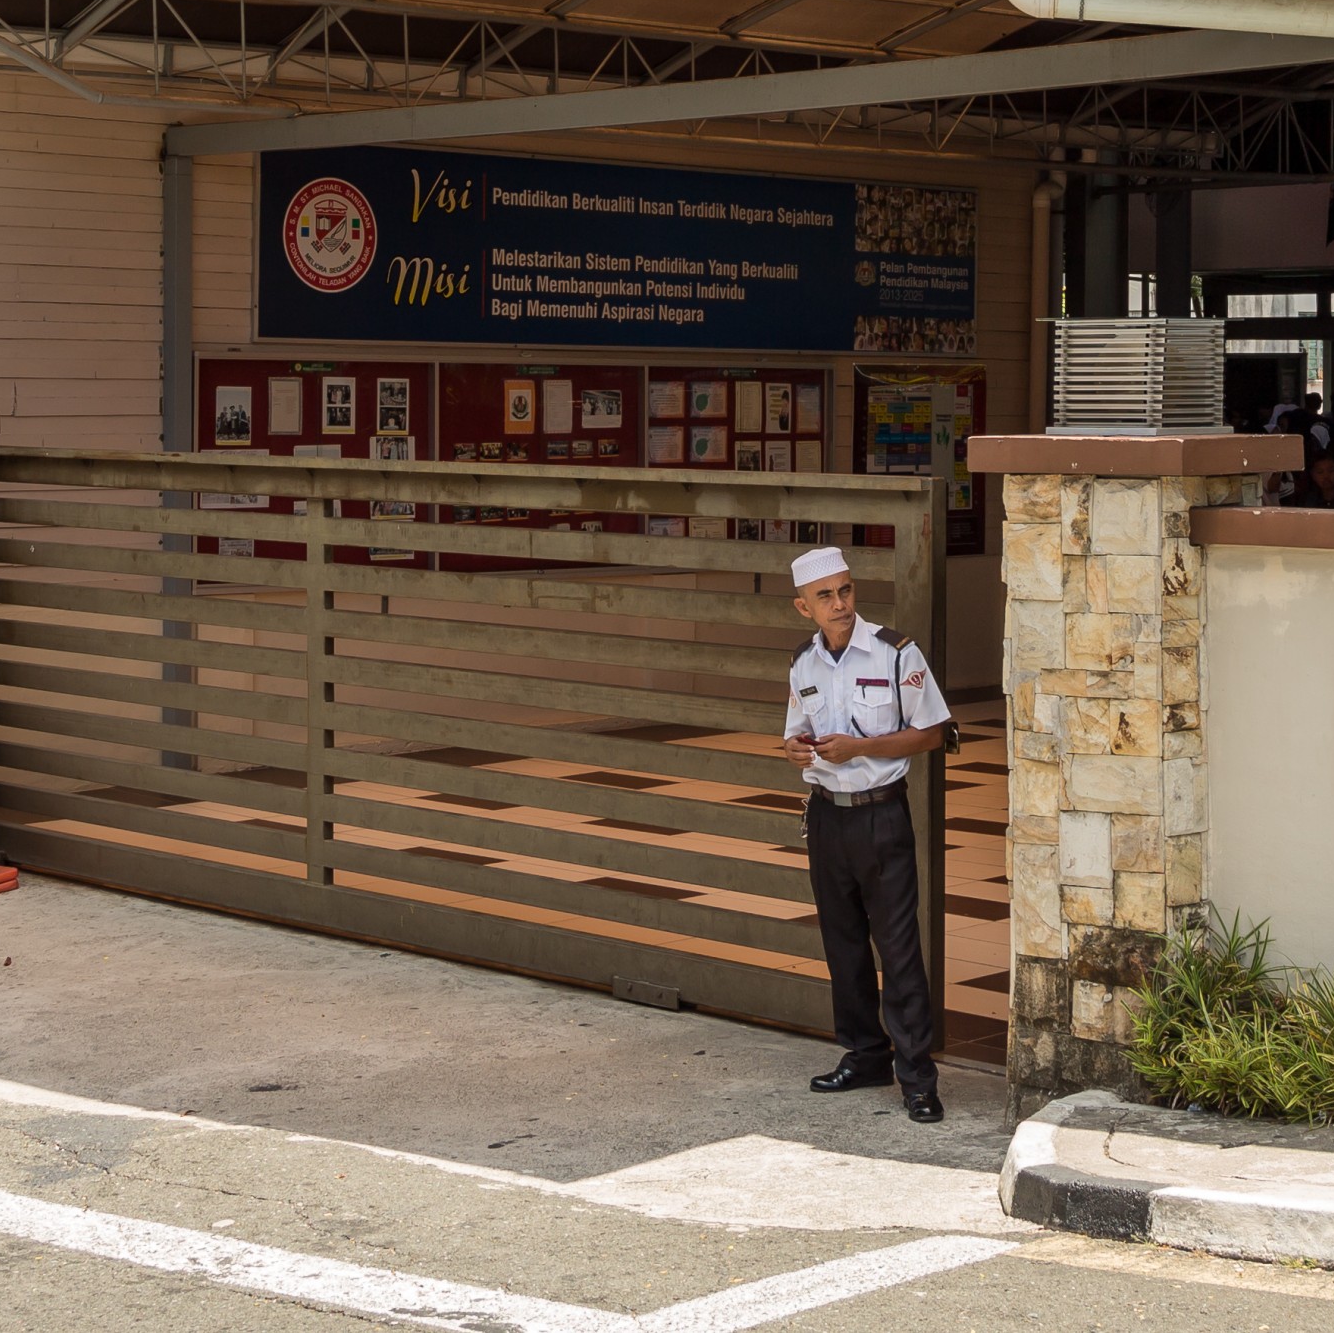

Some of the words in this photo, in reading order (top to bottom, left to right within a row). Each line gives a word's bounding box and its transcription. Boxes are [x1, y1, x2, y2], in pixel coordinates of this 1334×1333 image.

[312, 184, 342, 194] MICHAEL
[345, 189, 371, 229] SANDAKAN
[411, 168, 472, 223] Visi
[493, 187, 567, 209] Pendidikan
[572, 193, 634, 213] Berkualiti
[639, 198, 674, 216] Insan
[677, 200, 726, 219] Terdidik
[730, 204, 773, 225] Negara
[777, 208, 833, 227] Sejahtera
[290, 243, 316, 281] CONTOHILAH
[319, 277, 347, 286] TELADAN
[348, 265, 363, 279] YANG
[361, 247, 371, 265] BAIK
[305, 253, 327, 273] MELIORA
[492, 249, 581, 270] Melestarikan
[586, 253, 631, 272] Sistem
[635, 255, 704, 275] Pendidikan
[708, 260, 738, 280] Yang
[742, 261, 798, 280] Berkualiti
[880, 261, 905, 273] Pelan
[907, 263, 968, 278] Pembangunan
[386, 256, 470, 306] Misi
[492, 274, 532, 292] Untuk
[536, 276, 641, 298] Membangunkan
[646, 281, 693, 298] Potensi
[696, 282, 745, 300] Individu
[879, 289, 924, 301] 2013-2025
[880, 276, 928, 288] Pendidikan
[931, 278, 968, 292] Malaysia
[491, 299, 522, 320] Bagi
[527, 300, 597, 319] Memenuhi
[602, 303, 654, 323] Aspirasi
[659, 304, 704, 324] Negara
